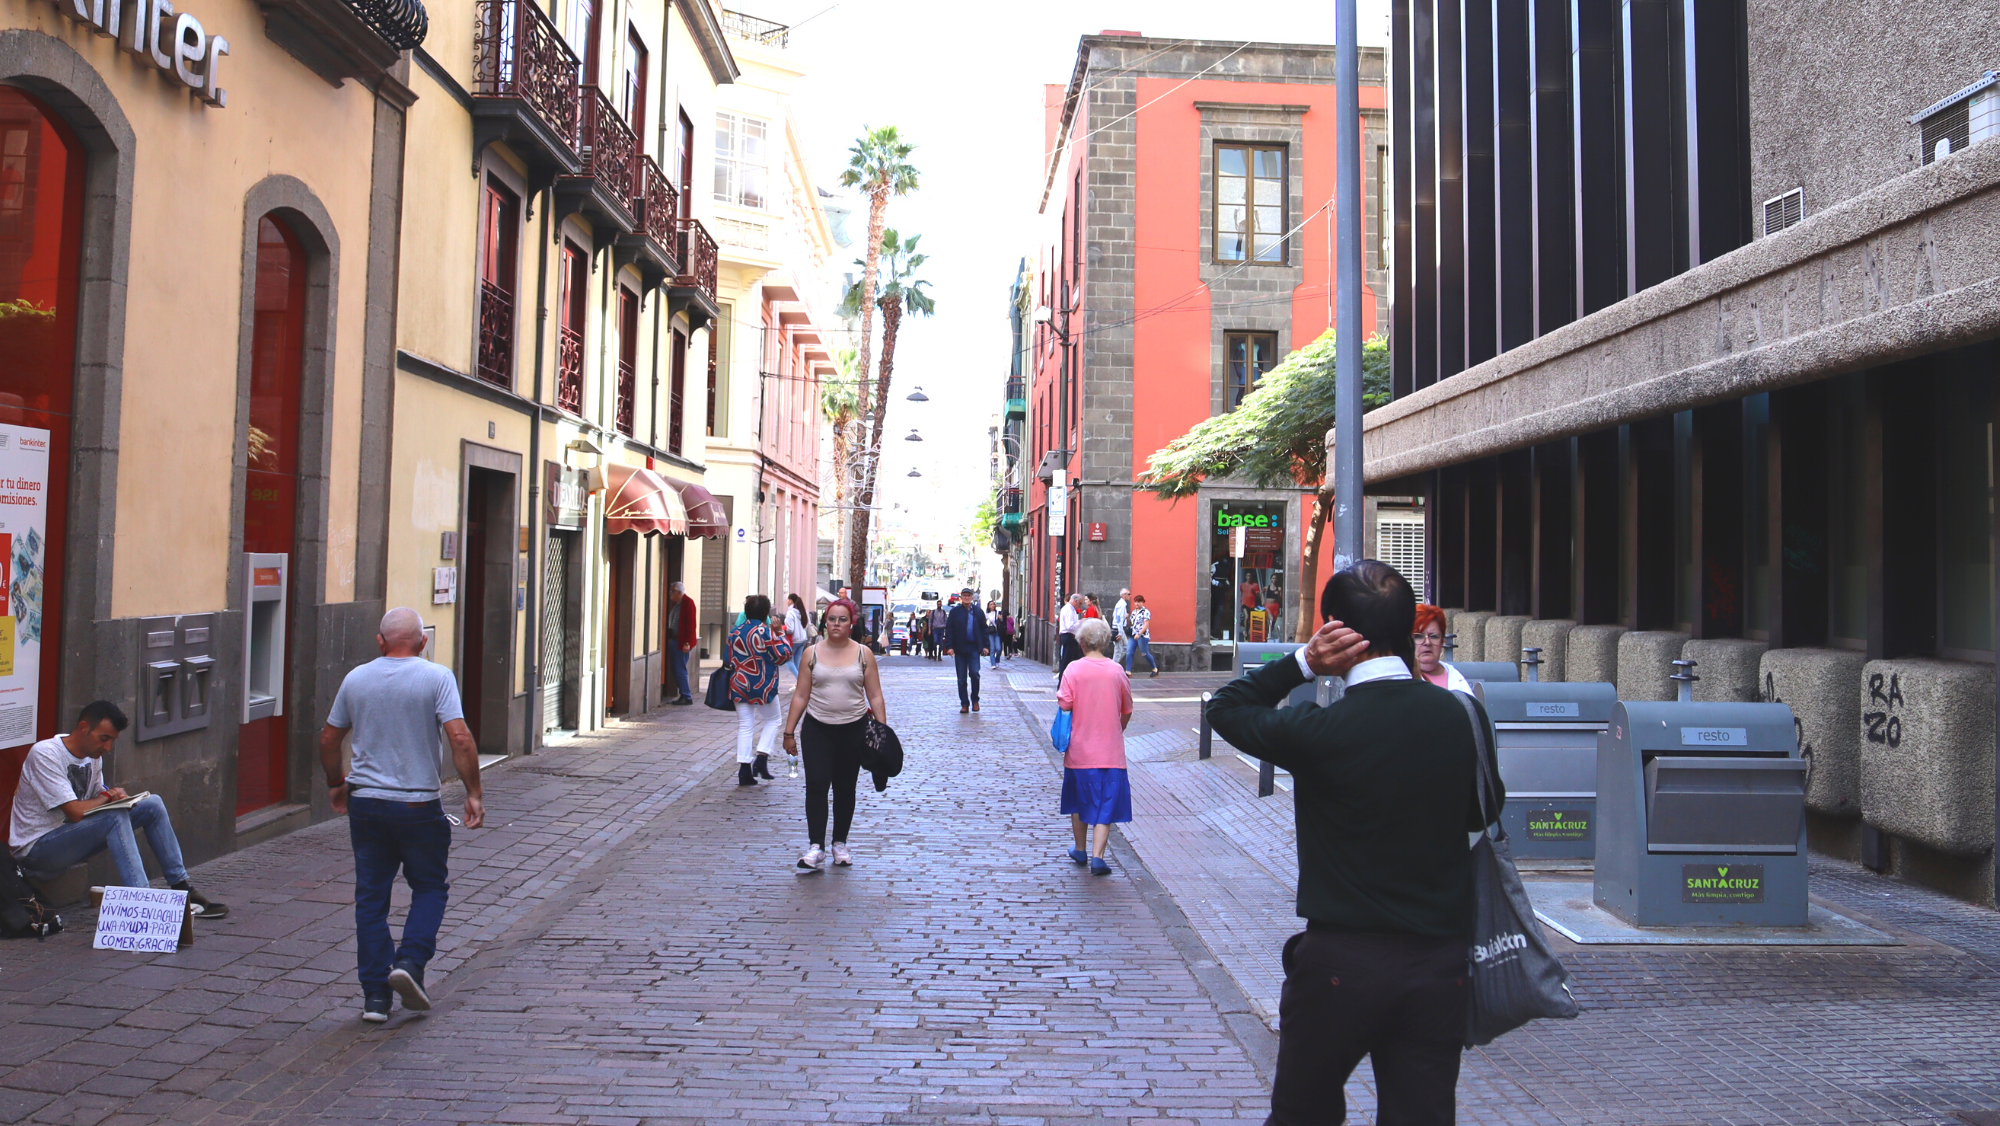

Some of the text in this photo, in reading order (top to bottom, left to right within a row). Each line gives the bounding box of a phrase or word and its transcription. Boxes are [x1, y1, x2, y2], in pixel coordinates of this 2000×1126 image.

[6, 478, 14, 489] tu
[17, 477, 41, 491] dinero
[0, 492, 38, 506] misiones.
[1869, 673, 1904, 710] RA
[1539, 703, 1566, 714] resto
[1698, 730, 1730, 742] resto
[1706, 890, 1728, 899] limpia,
[1729, 891, 1755, 899] contigo
